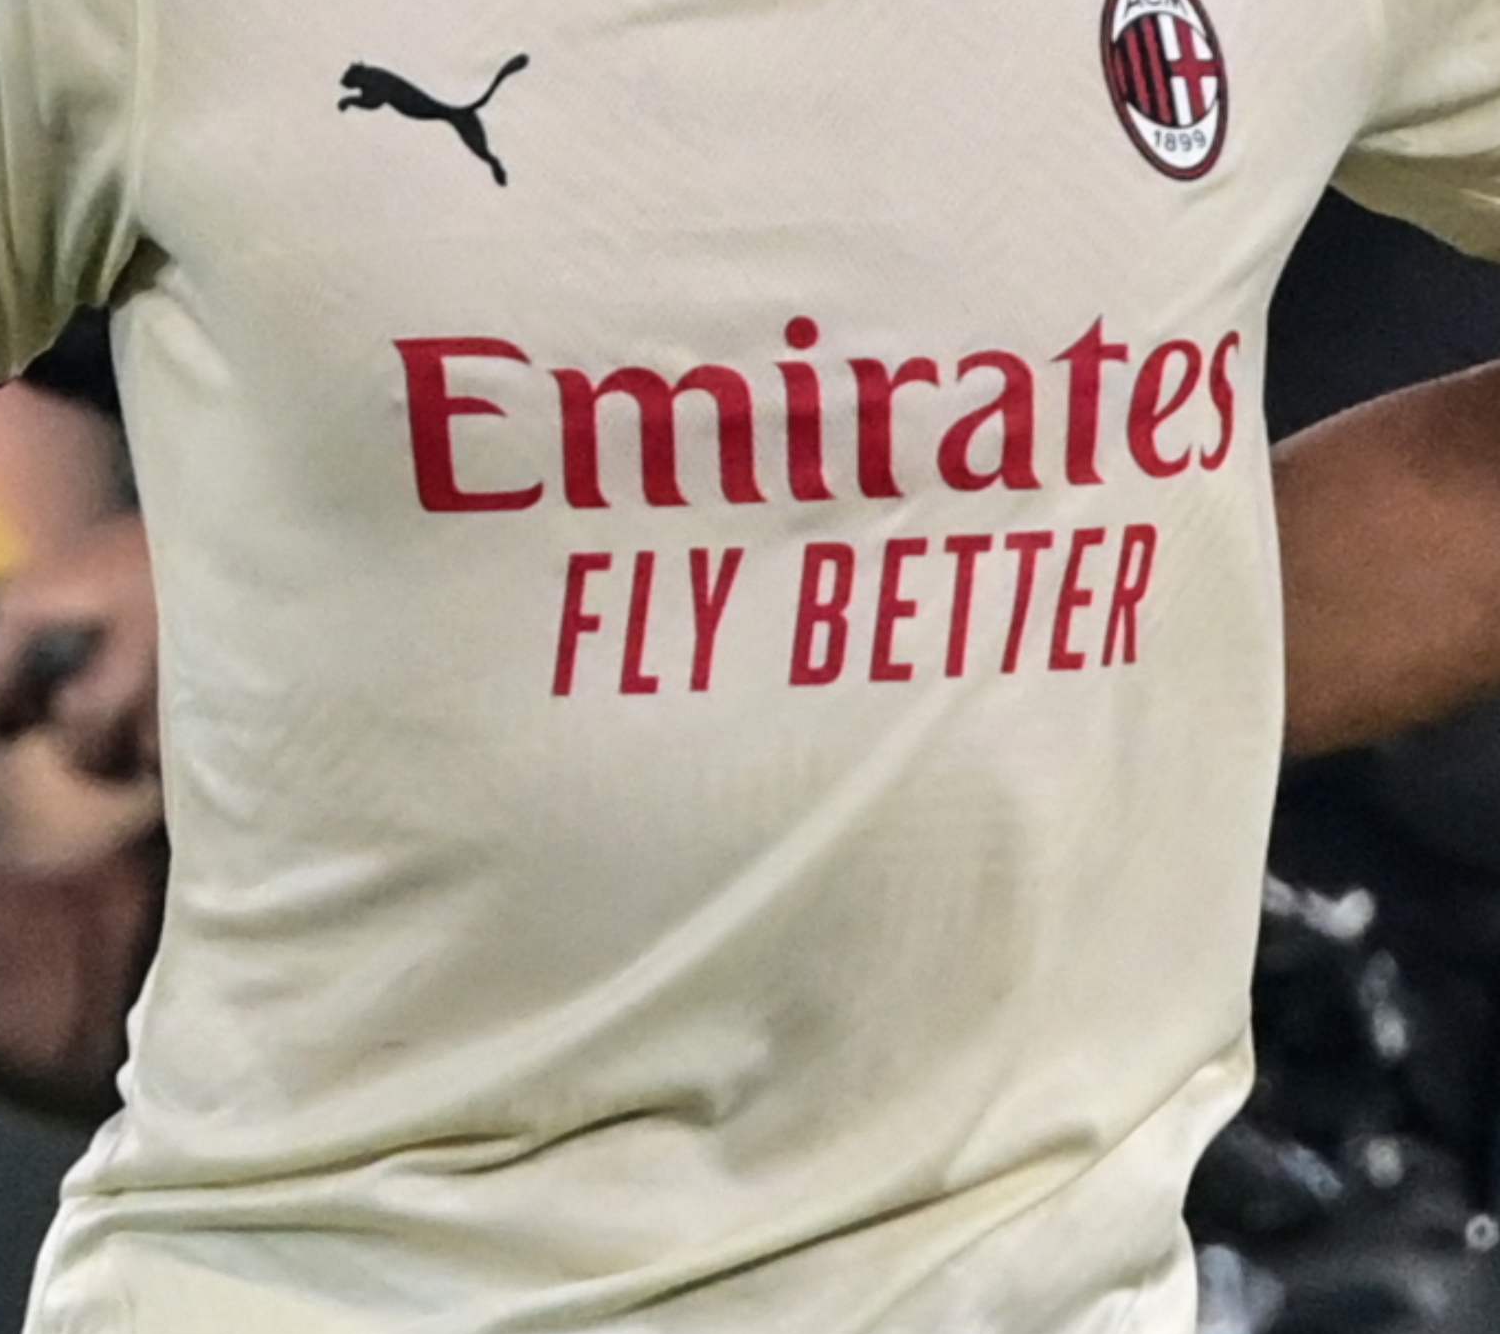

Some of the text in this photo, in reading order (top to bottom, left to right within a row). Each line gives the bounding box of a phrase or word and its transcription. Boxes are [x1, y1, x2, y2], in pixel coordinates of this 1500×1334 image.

[1153, 129, 1206, 152] 1899
[392, 315, 1240, 512] Emirates
[551, 524, 1157, 696] FLY BETTER
